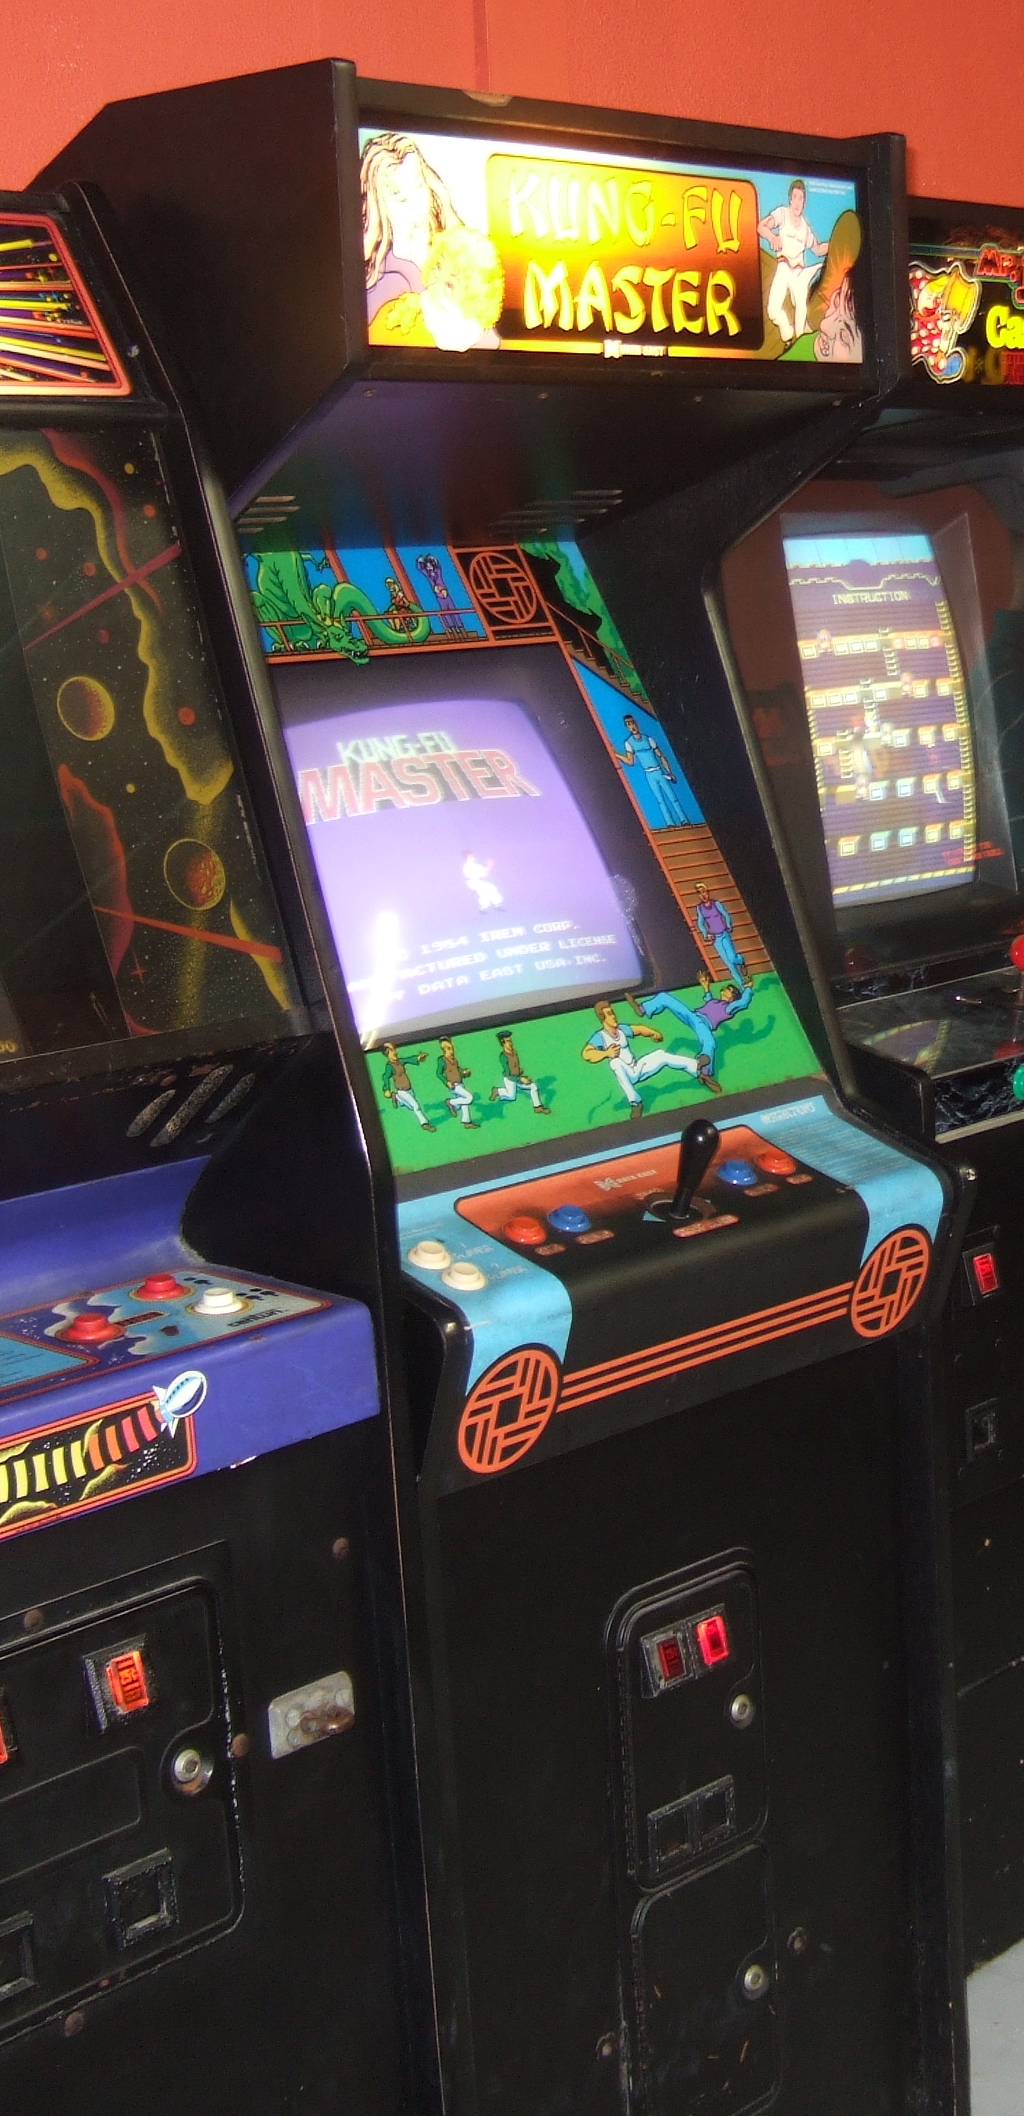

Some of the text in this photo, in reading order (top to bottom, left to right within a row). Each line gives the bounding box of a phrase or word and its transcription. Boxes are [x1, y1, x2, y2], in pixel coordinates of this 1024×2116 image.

[508, 168, 743, 253] KUNG-FU
[523, 259, 742, 337] MASTER
[832, 590, 911, 605] INSTRUCTION
[335, 731, 457, 764] KUNG-FU
[299, 749, 541, 826] MASTER
[532, 920, 580, 934] CORP.
[496, 941, 551, 959] UNDER
[558, 934, 617, 950] LICENSE
[418, 975, 470, 995] DATA
[479, 964, 524, 981] EAST
